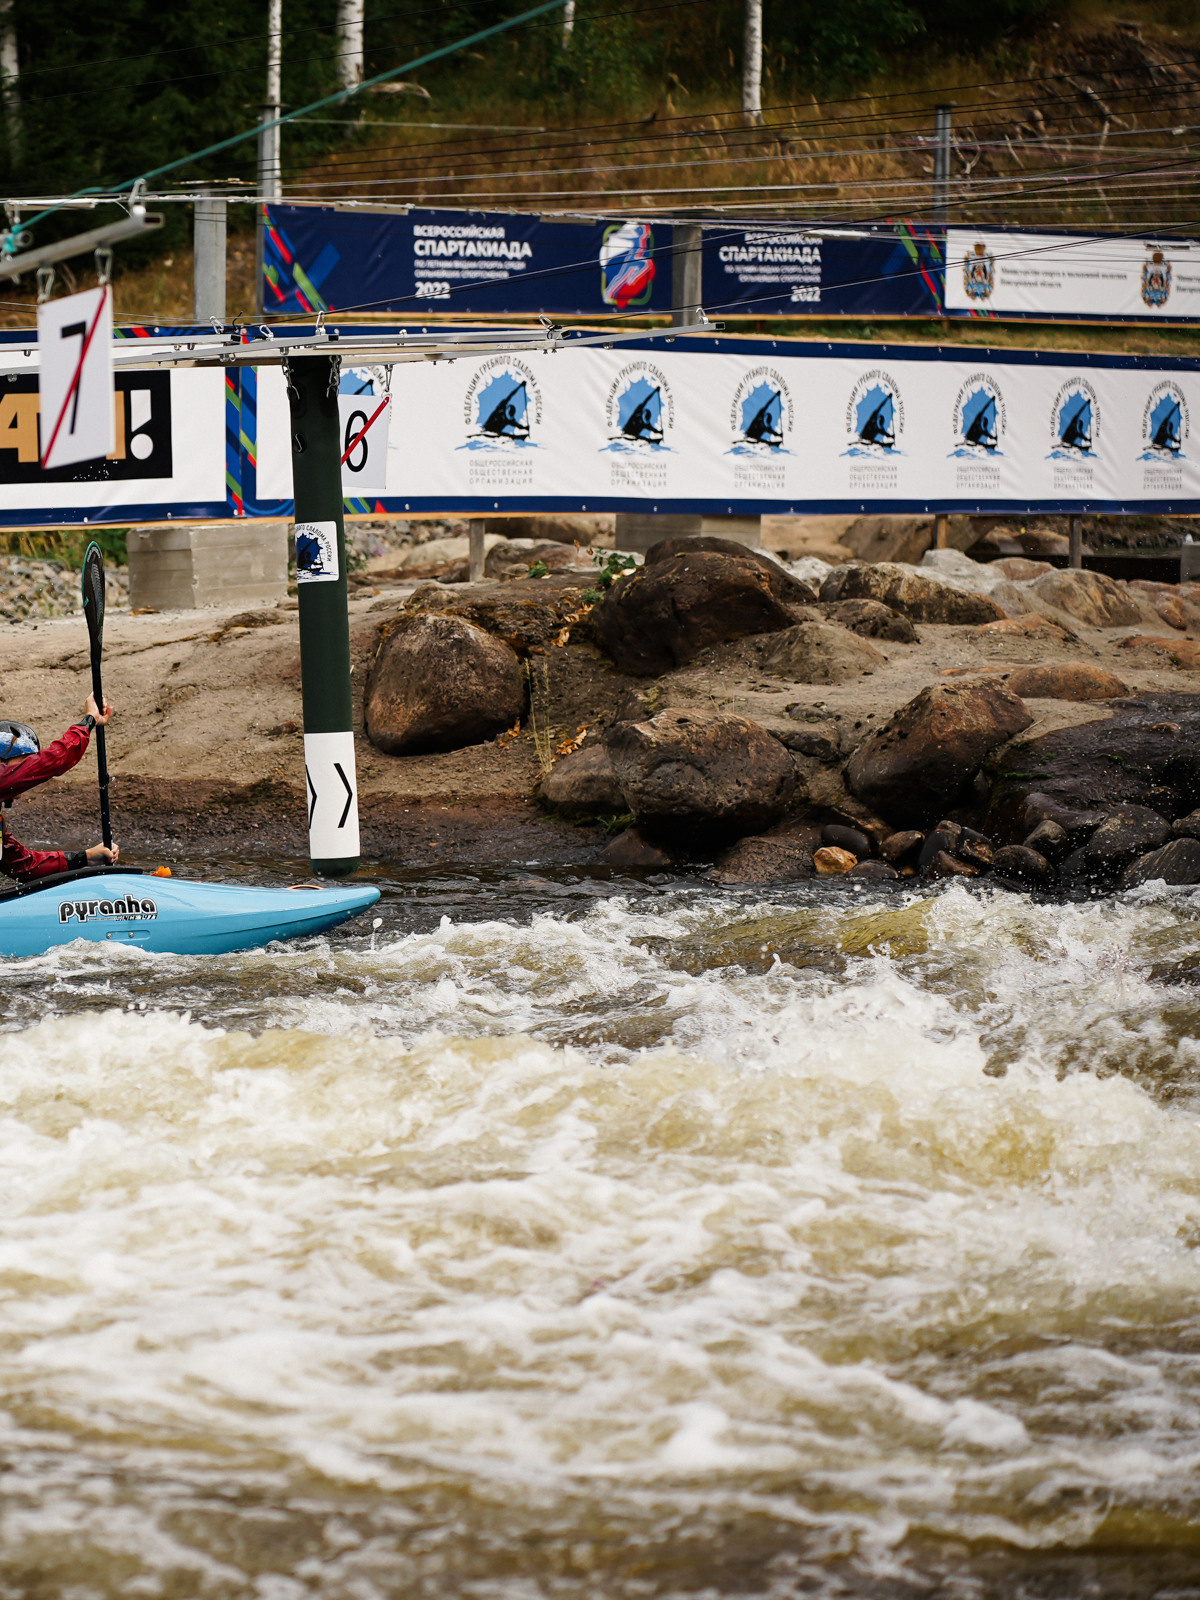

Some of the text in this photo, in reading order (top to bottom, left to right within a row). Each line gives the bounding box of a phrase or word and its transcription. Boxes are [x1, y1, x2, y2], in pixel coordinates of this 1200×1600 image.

[413, 224, 506, 239] ВСЕРОССИЙСКАЯ
[413, 239, 533, 260] СПАРТАКИАДА
[719, 245, 822, 264] СПАРТАКИАДА
[414, 281, 451, 299] 2022
[790, 285, 821, 302] 2022
[60, 321, 87, 435] 7
[619, 360, 647, 379] ГРЕБНОГО
[648, 361, 670, 392] СЛАЛОМА
[463, 355, 543, 425] ФЕДЕРАЦИЯ ГРЕБНОГО СЛАЛОМА РОССИИ
[344, 410, 369, 472] 6
[469, 459, 533, 467] ОБЩЕРОССИЙСКАЯ
[58, 893, 158, 924] pyranha
